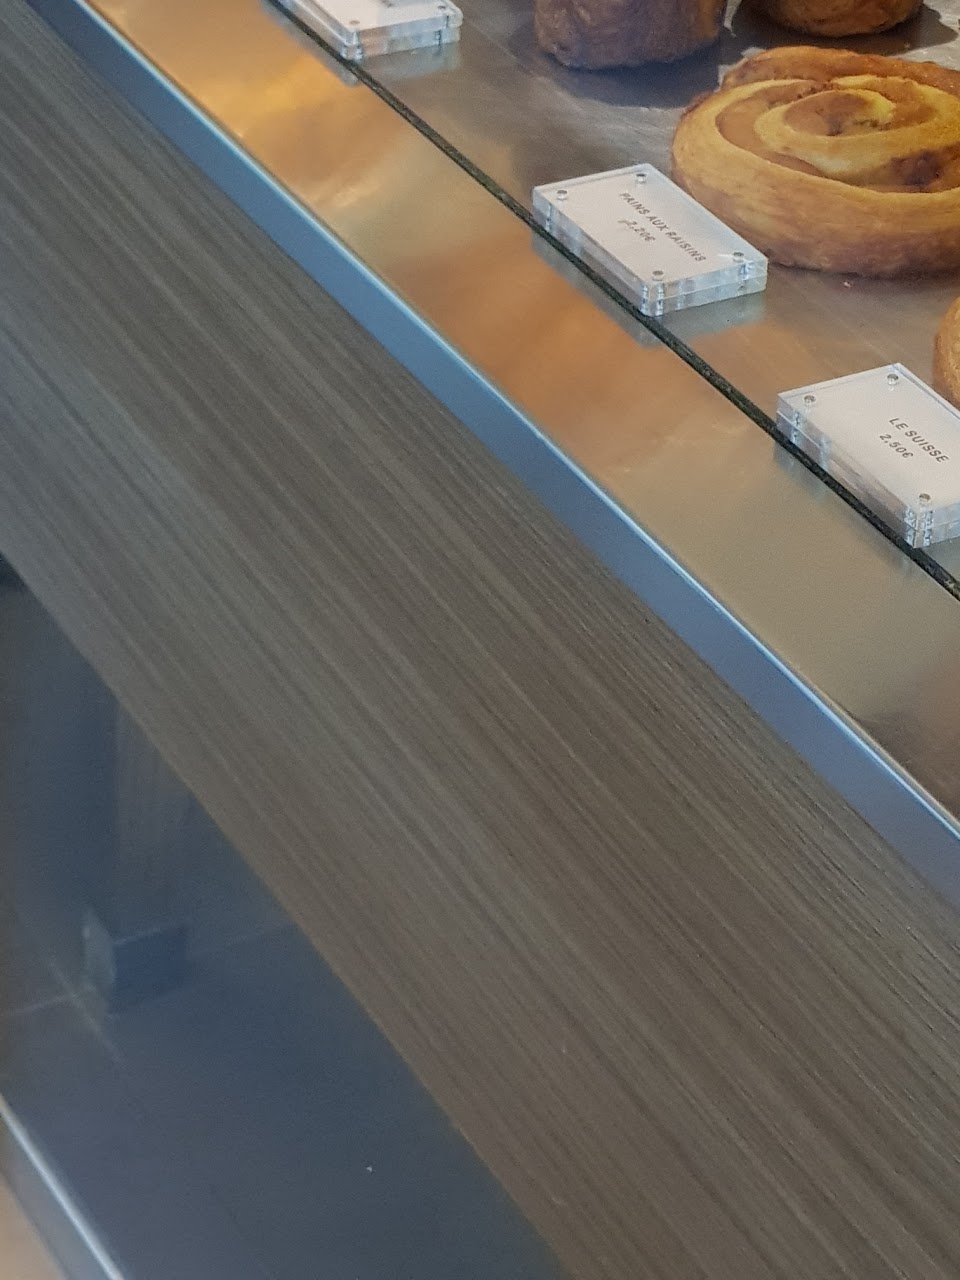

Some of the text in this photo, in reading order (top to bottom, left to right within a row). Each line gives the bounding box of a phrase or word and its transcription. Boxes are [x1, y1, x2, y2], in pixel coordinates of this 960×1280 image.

[619, 192, 651, 215] PAINS
[647, 216, 669, 232] AUX
[888, 417, 950, 463] LE SUISSE
